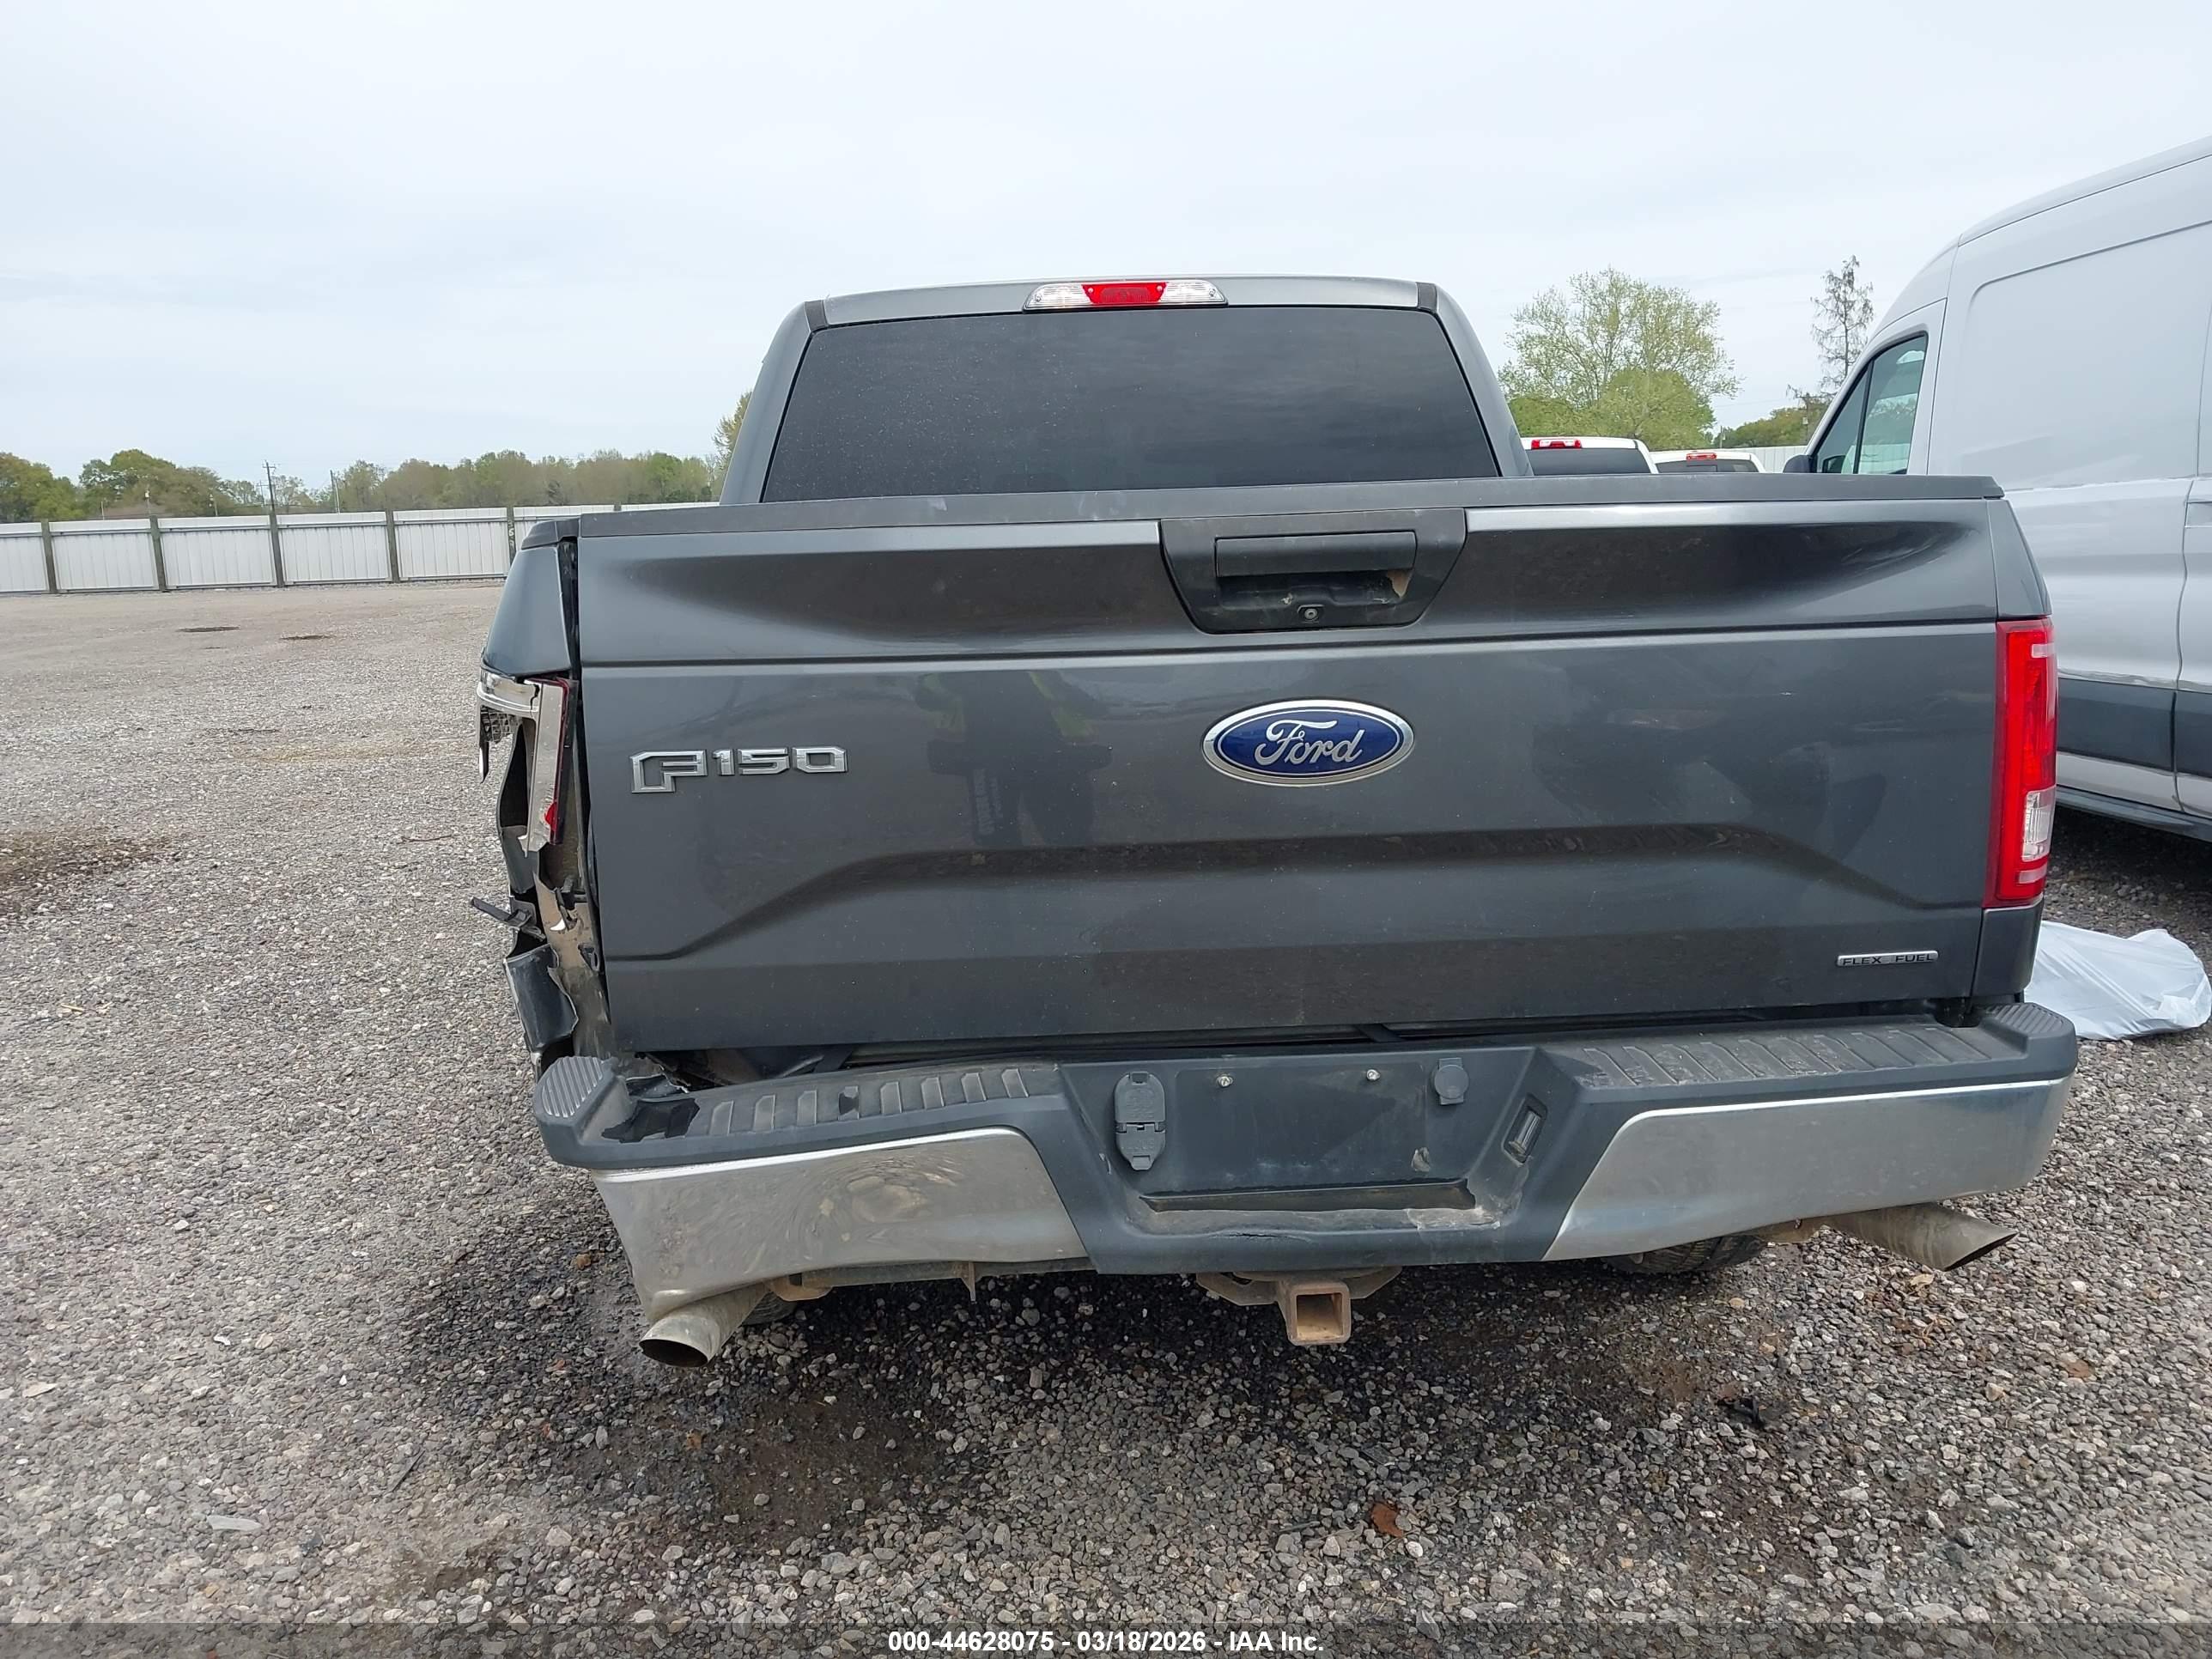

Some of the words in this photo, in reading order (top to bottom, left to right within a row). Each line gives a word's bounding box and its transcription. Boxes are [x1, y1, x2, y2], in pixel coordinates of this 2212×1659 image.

[1254, 719, 1365, 766] Ford
[1843, 957, 1882, 966] FLEX
[1895, 954, 1934, 963] FUEL
